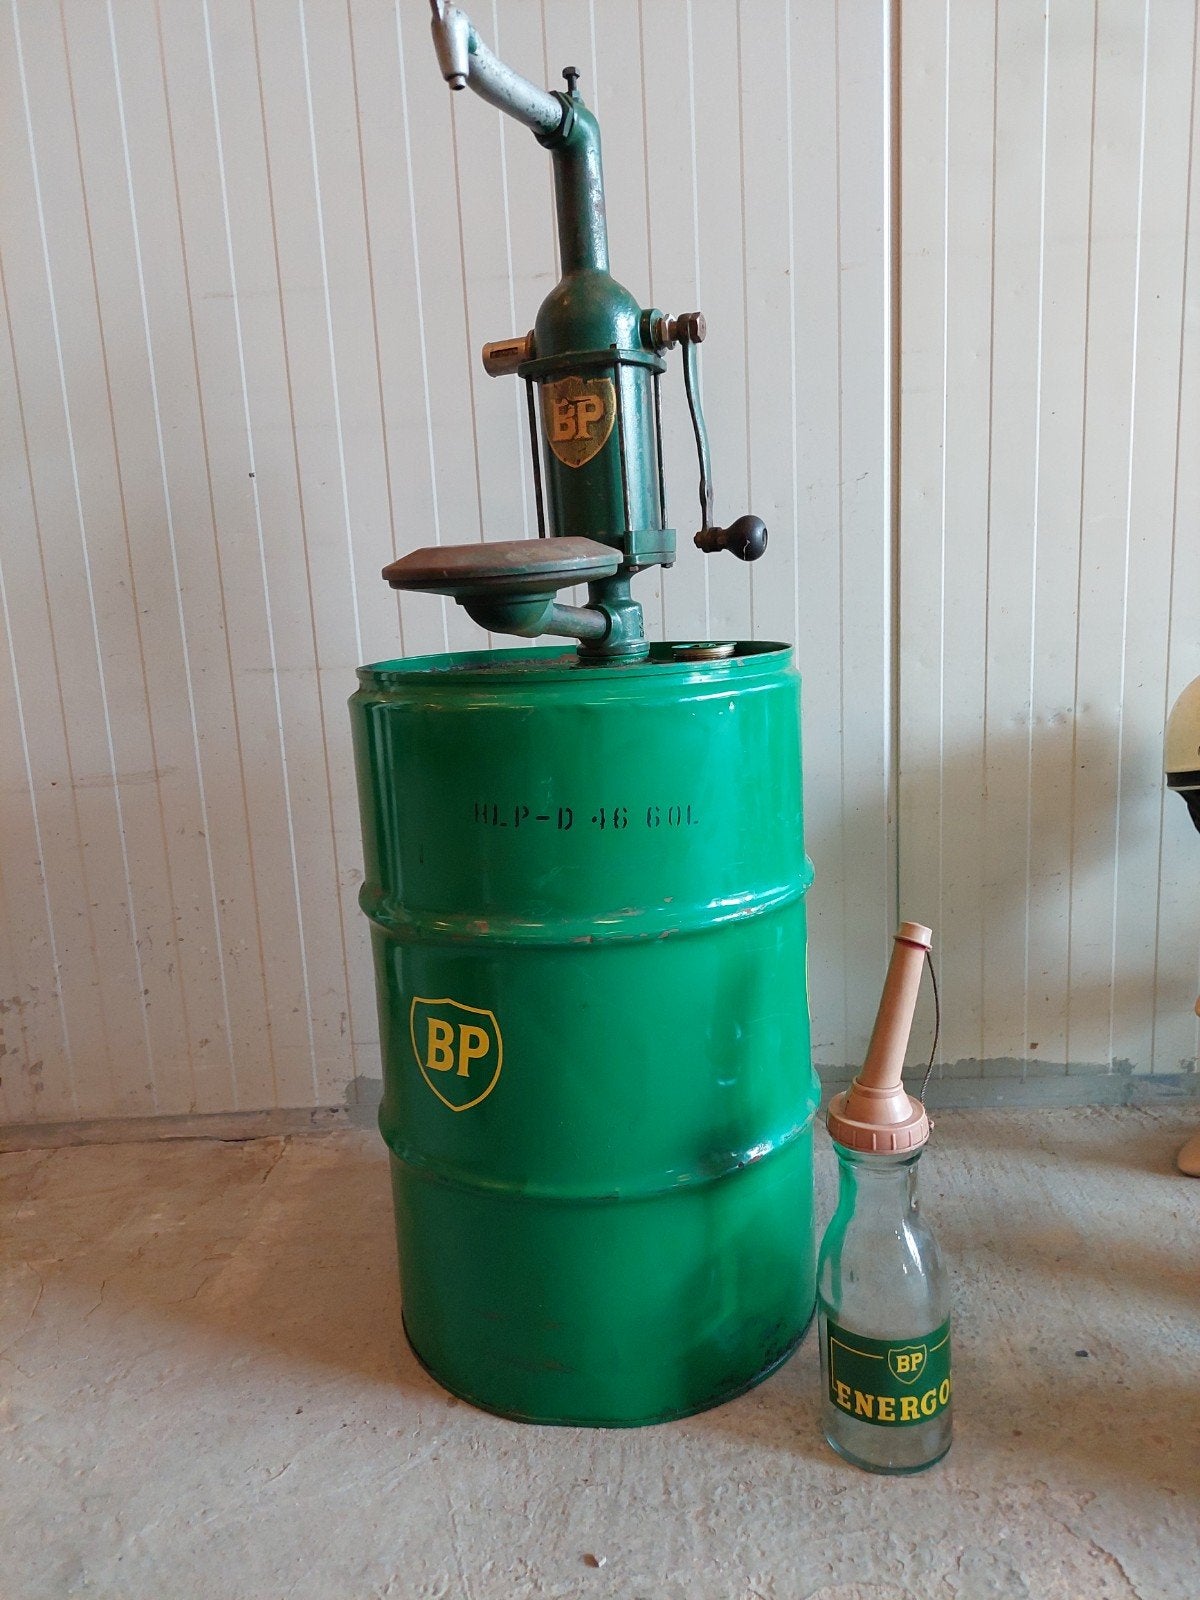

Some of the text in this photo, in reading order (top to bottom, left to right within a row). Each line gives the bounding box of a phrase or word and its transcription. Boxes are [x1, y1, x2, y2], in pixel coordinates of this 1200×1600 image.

[553, 395, 604, 441] BP
[425, 1017, 490, 1077] BP
[896, 1352, 923, 1373] BP
